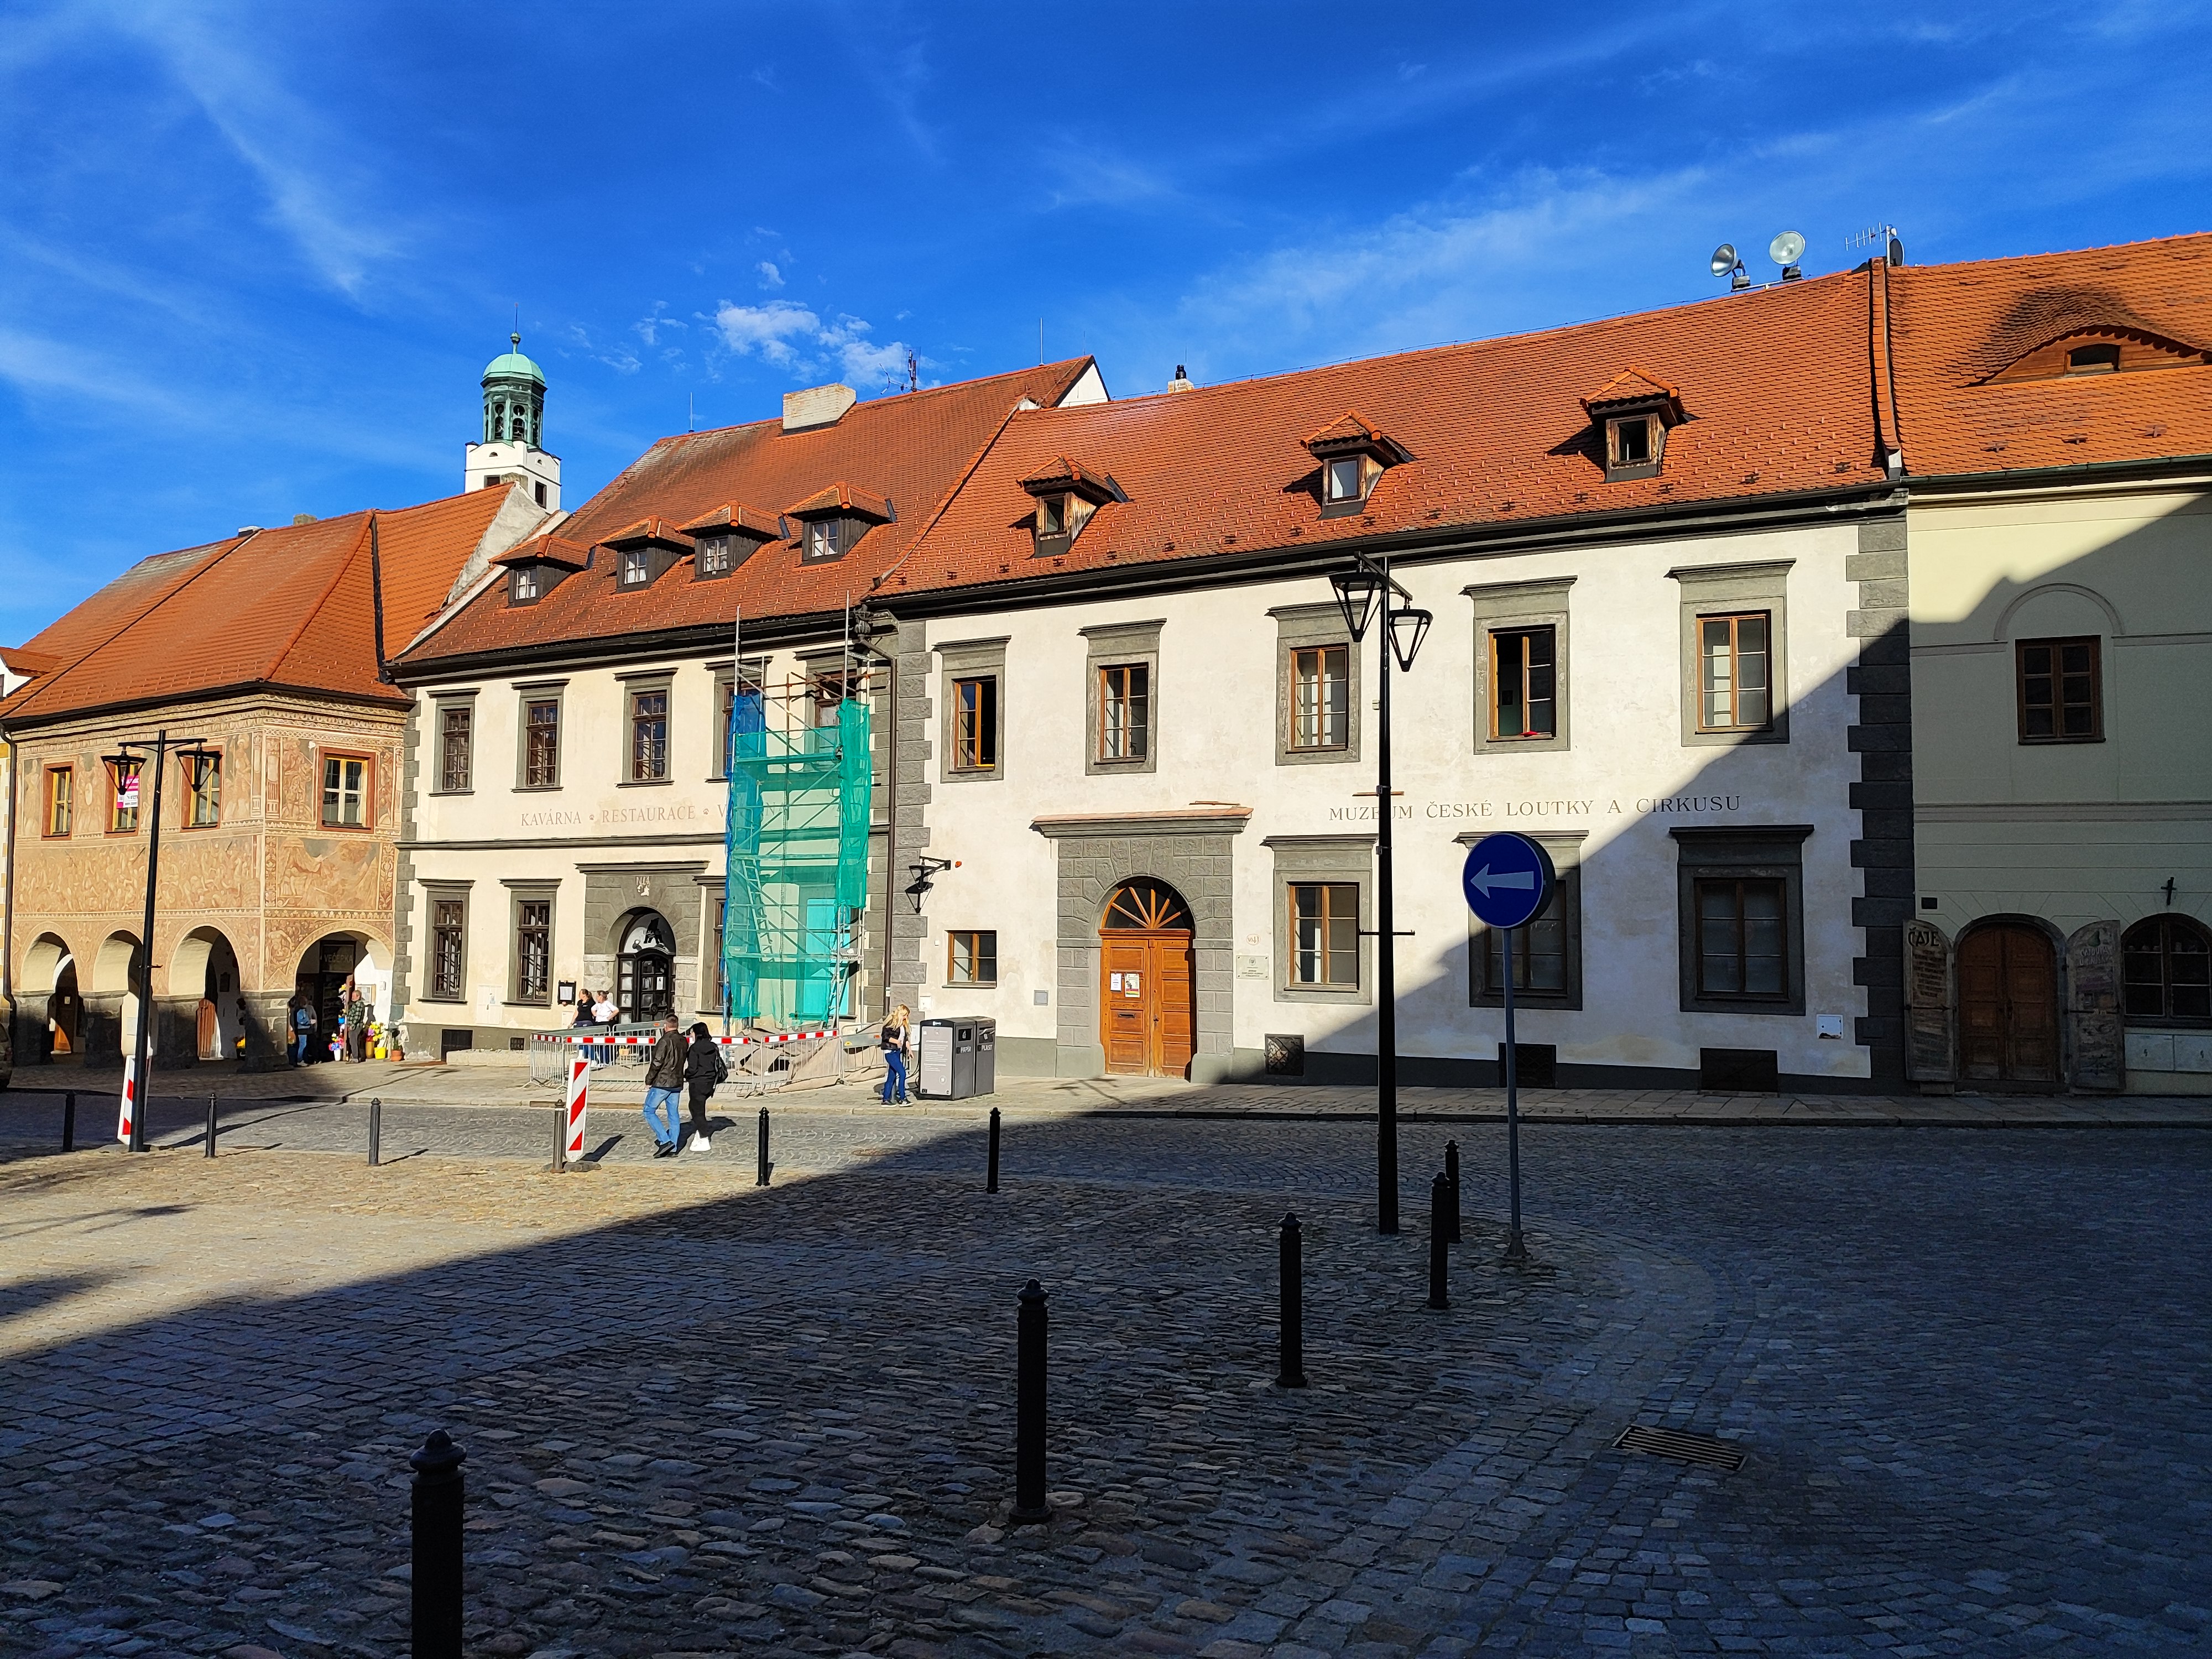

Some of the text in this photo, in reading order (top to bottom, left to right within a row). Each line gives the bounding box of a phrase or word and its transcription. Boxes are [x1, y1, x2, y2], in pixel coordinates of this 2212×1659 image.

[521, 806, 695, 826] KAVÁRNA RESTAURACE
[1426, 800, 1493, 818] ČESKÉ
[1506, 800, 1594, 816] LOUTKY
[1606, 800, 1622, 813] A
[1636, 796, 1740, 813] CIRKUSU
[1908, 927, 1939, 947] ČAJE
[324, 952, 353, 963] VEČERKA
